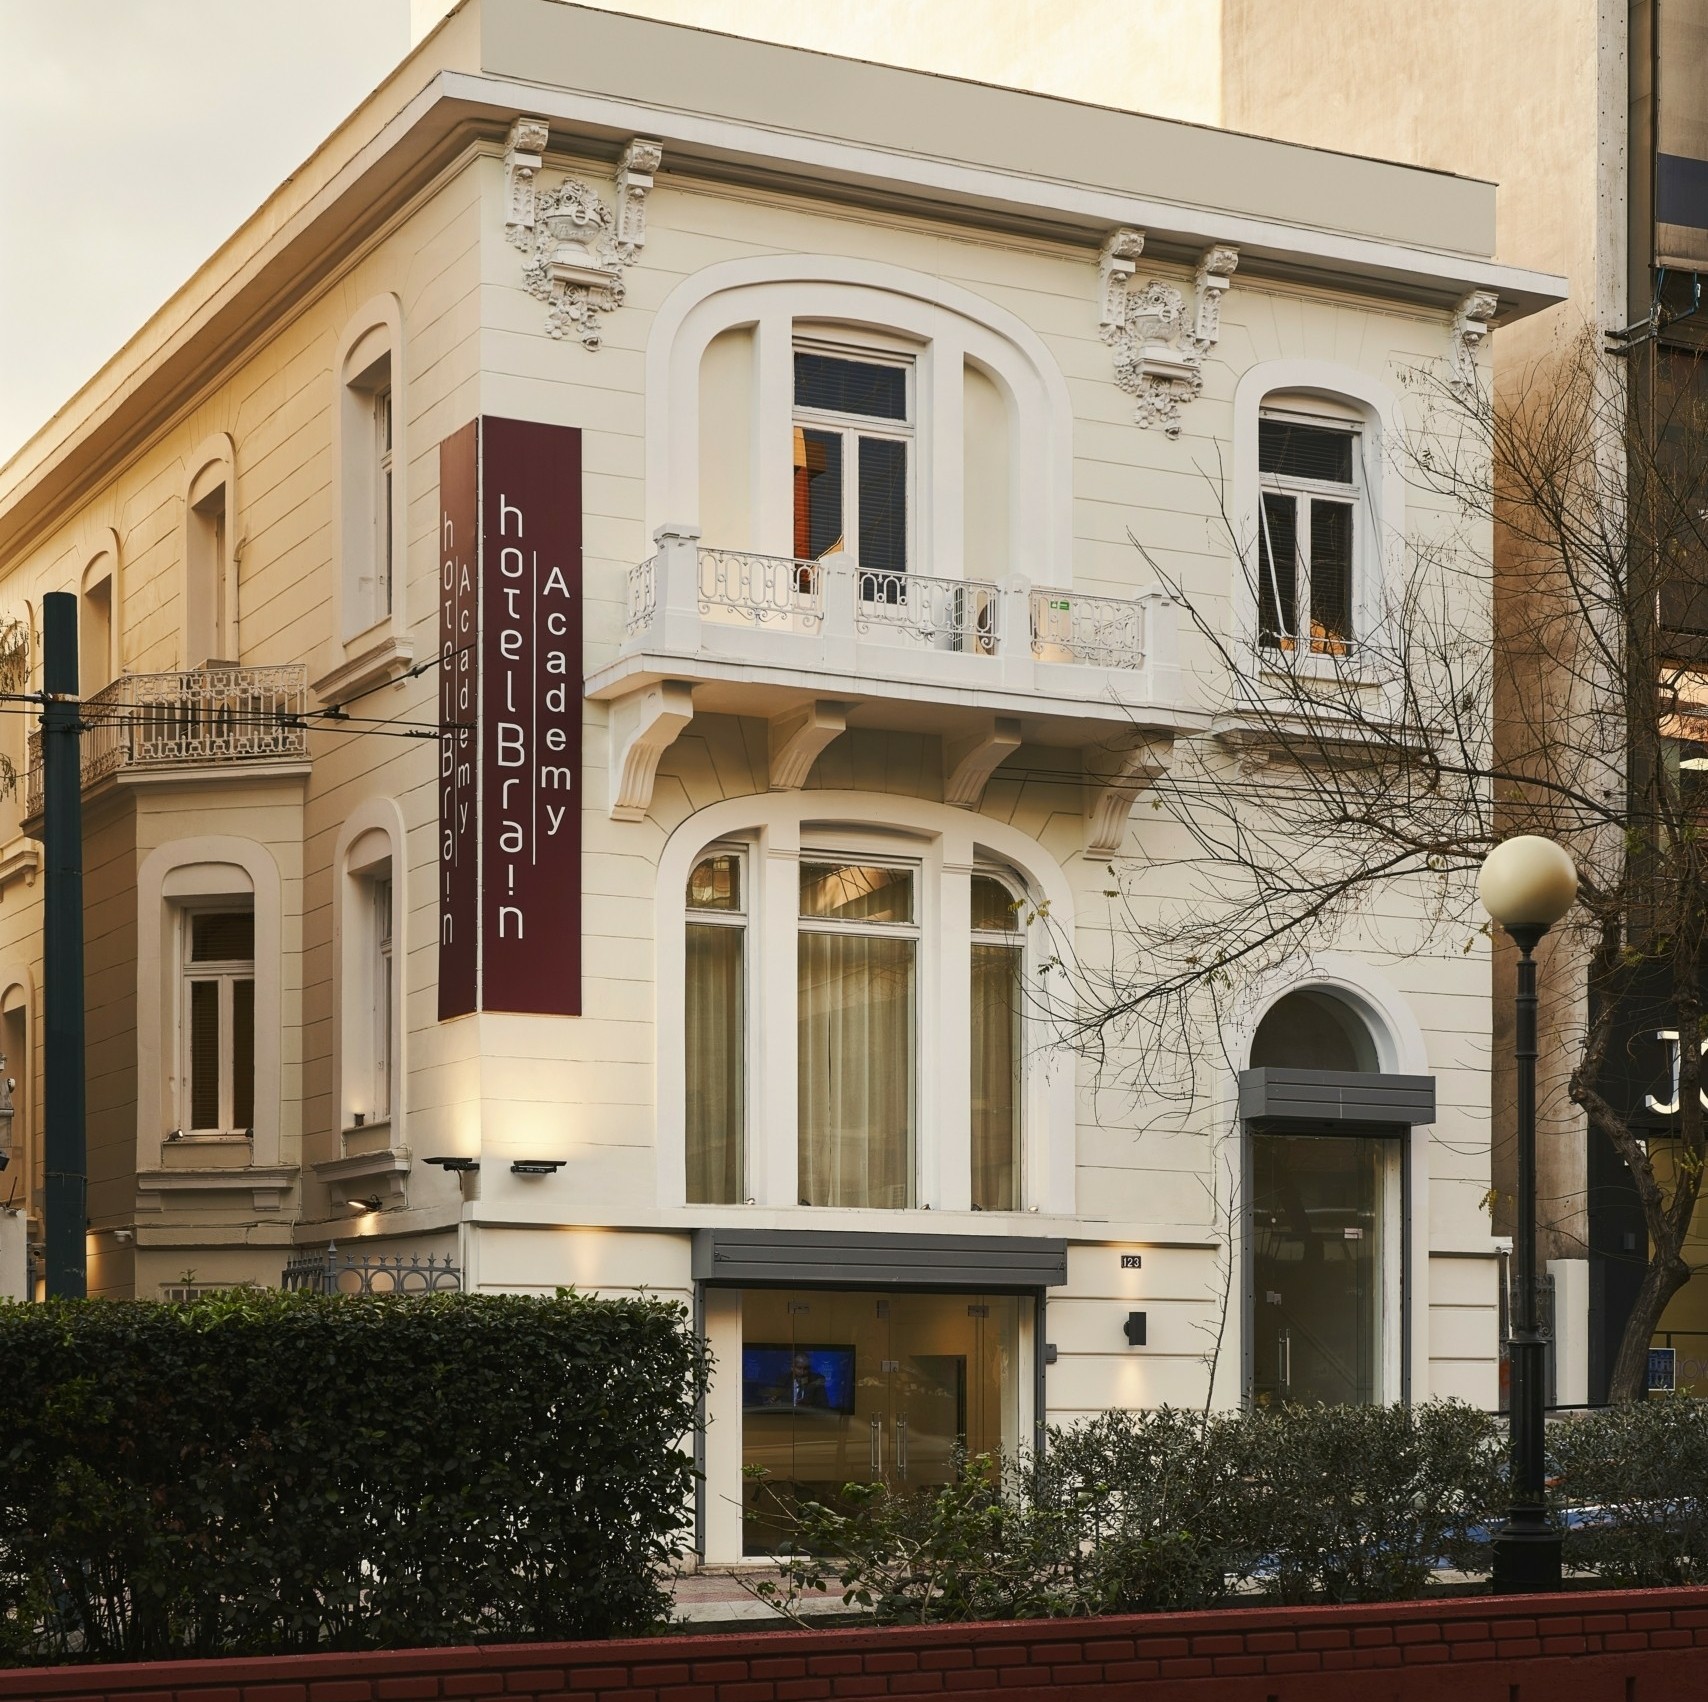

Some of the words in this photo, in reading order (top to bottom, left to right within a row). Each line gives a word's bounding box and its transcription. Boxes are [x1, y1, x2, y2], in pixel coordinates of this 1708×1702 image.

[457, 563, 471, 834] Academy
[541, 566, 571, 836] Academy
[1123, 1257, 1140, 1268] 123
